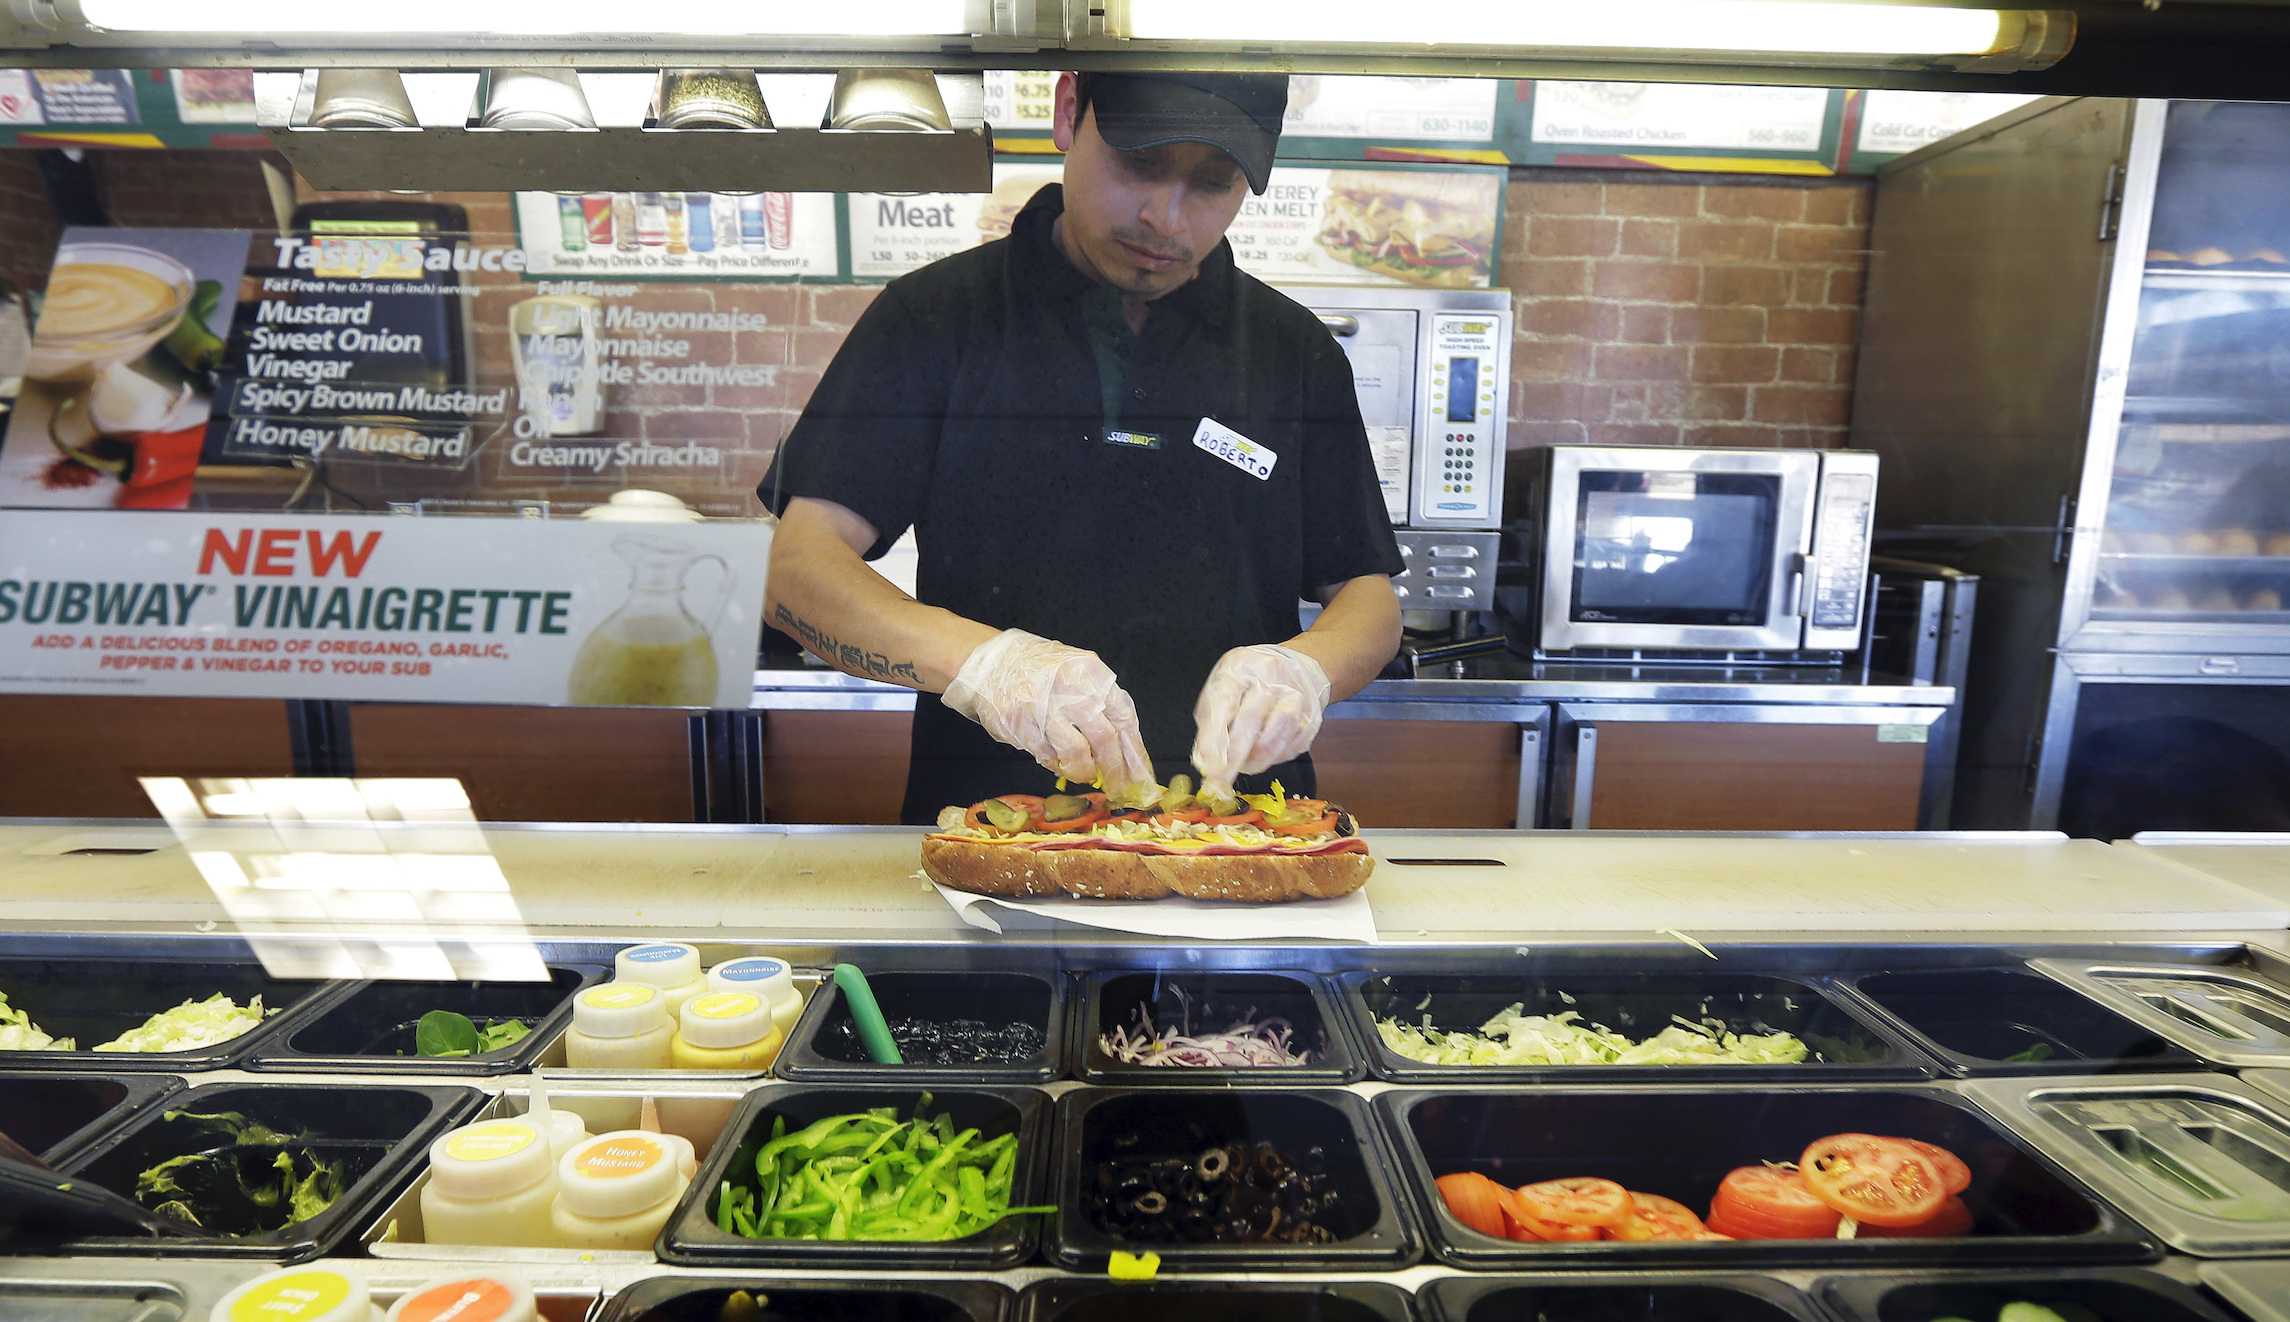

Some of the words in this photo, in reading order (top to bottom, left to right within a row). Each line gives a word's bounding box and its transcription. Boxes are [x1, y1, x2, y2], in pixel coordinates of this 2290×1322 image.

[1015, 84, 1050, 97] $6.75
[1016, 104, 1050, 118] $5.25
[1544, 123, 1579, 137] Oven
[1582, 125, 1633, 139] Roasted
[1636, 124, 1687, 140] Chicken
[1872, 123, 1900, 137] Cold
[1903, 124, 1926, 138] Cut
[1257, 184, 1319, 200] TEREY
[878, 199, 956, 228] Meat
[1273, 202, 1318, 217] MELT
[274, 237, 391, 279] Tasty
[552, 255, 584, 269] Swap
[587, 255, 609, 269] Any
[611, 255, 642, 267] Drink
[644, 256, 660, 267] Or
[720, 256, 748, 268] Price
[262, 278, 290, 292] Fat
[290, 278, 325, 293] Free
[326, 280, 348, 294] Per
[348, 282, 374, 294] 0.75
[375, 284, 390, 294] oz
[437, 284, 481, 297] serving
[536, 279, 574, 296] Full
[576, 281, 638, 297] Flavor
[256, 300, 373, 325] Mustard
[531, 304, 602, 331] Light
[605, 305, 768, 333] Mayonnaise
[250, 325, 333, 351] Sweet
[337, 327, 423, 352] Onion
[527, 330, 691, 361] Mayonnaise
[245, 353, 353, 385] Vinegar
[523, 359, 634, 388] Chiptle
[636, 361, 779, 388] Southwest
[240, 382, 310, 414] Spicy
[310, 384, 395, 410] Brown
[397, 386, 506, 414] Mustard
[235, 418, 336, 455] Honey
[337, 425, 466, 457] Mustard
[1106, 431, 1157, 446] SUBWAY
[509, 441, 609, 472] Creamy
[613, 441, 720, 468] Sriracha
[1199, 431, 1269, 477] ROBERTO
[196, 527, 383, 579] NEW
[233, 584, 573, 635] VINAIGRETTE
[31, 634, 75, 649] ADD
[79, 635, 95, 649] A
[101, 635, 206, 652] DELICIOUS
[212, 637, 279, 653] BLEND
[284, 639, 311, 654] OF
[317, 639, 423, 658] OREGANO,
[429, 642, 509, 660] GARLIC,
[99, 655, 177, 671] PEPPER
[181, 656, 195, 671] &
[201, 656, 291, 673] VINEGAR
[297, 658, 325, 674] TO
[330, 659, 386, 675] YOUR
[390, 661, 433, 676] SUB
[721, 965, 781, 976] MAYONNAISE
[587, 1156, 646, 1168] MUSTARD
[605, 1146, 647, 1158] HONEY
